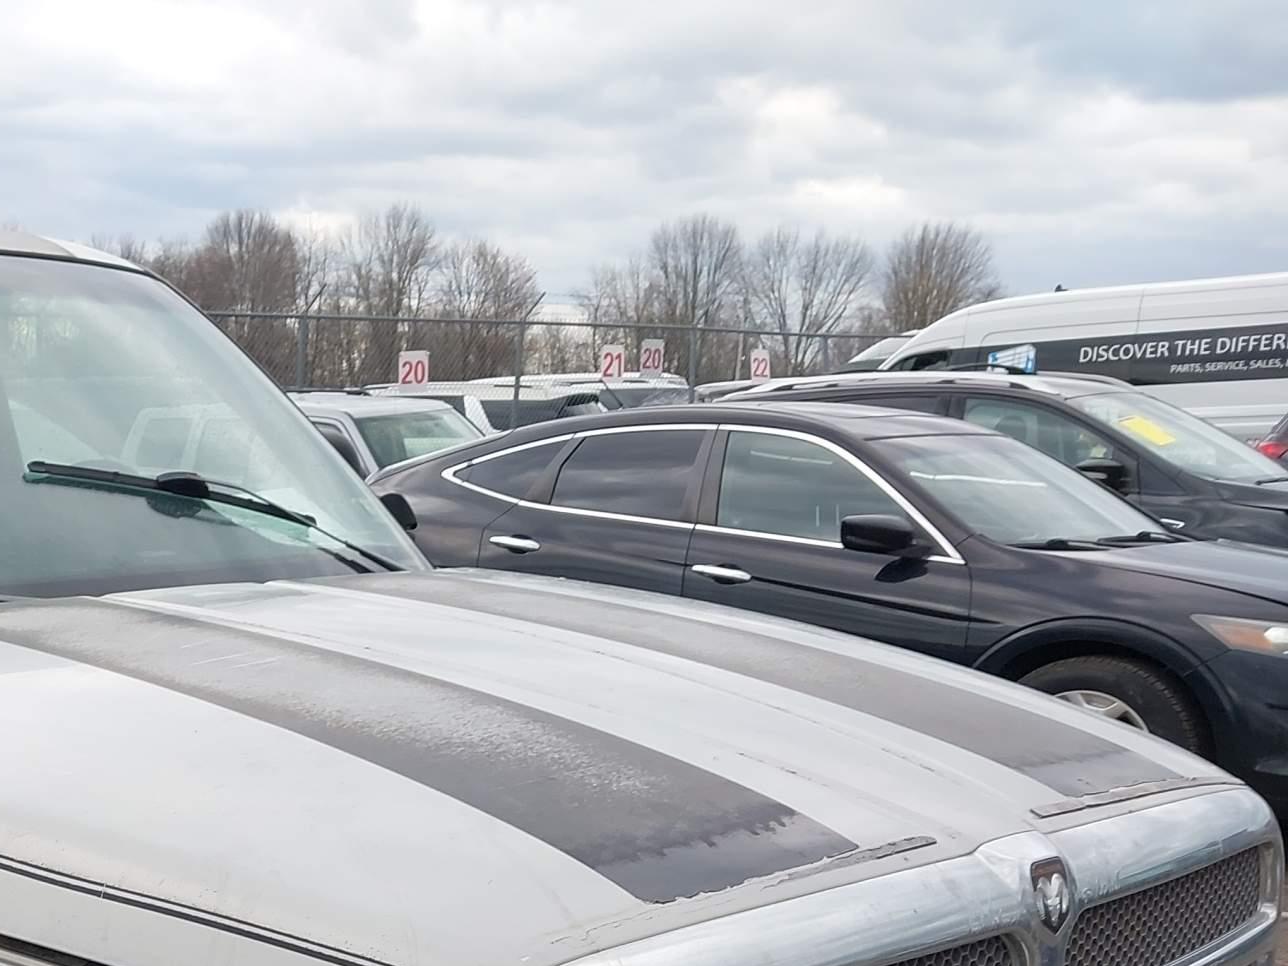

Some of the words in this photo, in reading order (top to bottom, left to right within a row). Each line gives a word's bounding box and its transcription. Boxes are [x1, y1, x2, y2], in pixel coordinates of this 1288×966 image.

[642, 348, 662, 369] 20
[1079, 341, 1169, 363] DISCOVER
[1174, 338, 1212, 357] THE
[1215, 333, 1288, 355] DIFFER
[402, 360, 425, 384] 20
[603, 352, 622, 377] 21
[753, 358, 768, 377] 22
[1170, 362, 1203, 374] PARTS,
[1204, 359, 1248, 371] SERVICE,
[1249, 358, 1284, 369] SALES,
